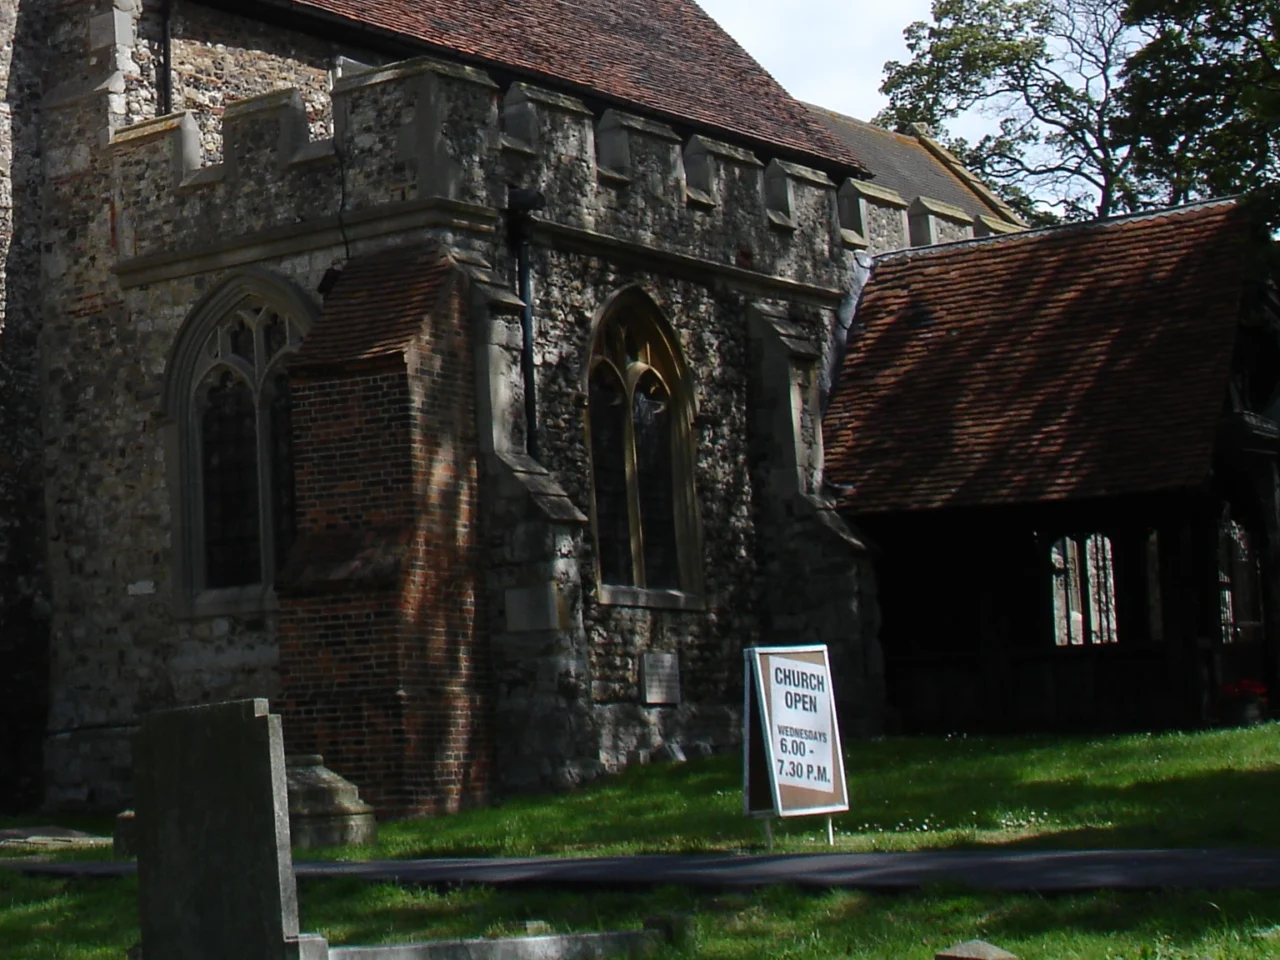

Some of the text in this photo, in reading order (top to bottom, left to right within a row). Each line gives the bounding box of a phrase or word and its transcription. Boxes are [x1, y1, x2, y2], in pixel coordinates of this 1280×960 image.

[774, 667, 825, 692] CHURCH
[785, 691, 817, 713] OPEN
[777, 725, 827, 743] WEDNESDAYS
[780, 738, 806, 756] 6.00
[777, 759, 830, 783] 7.30 P.M.
